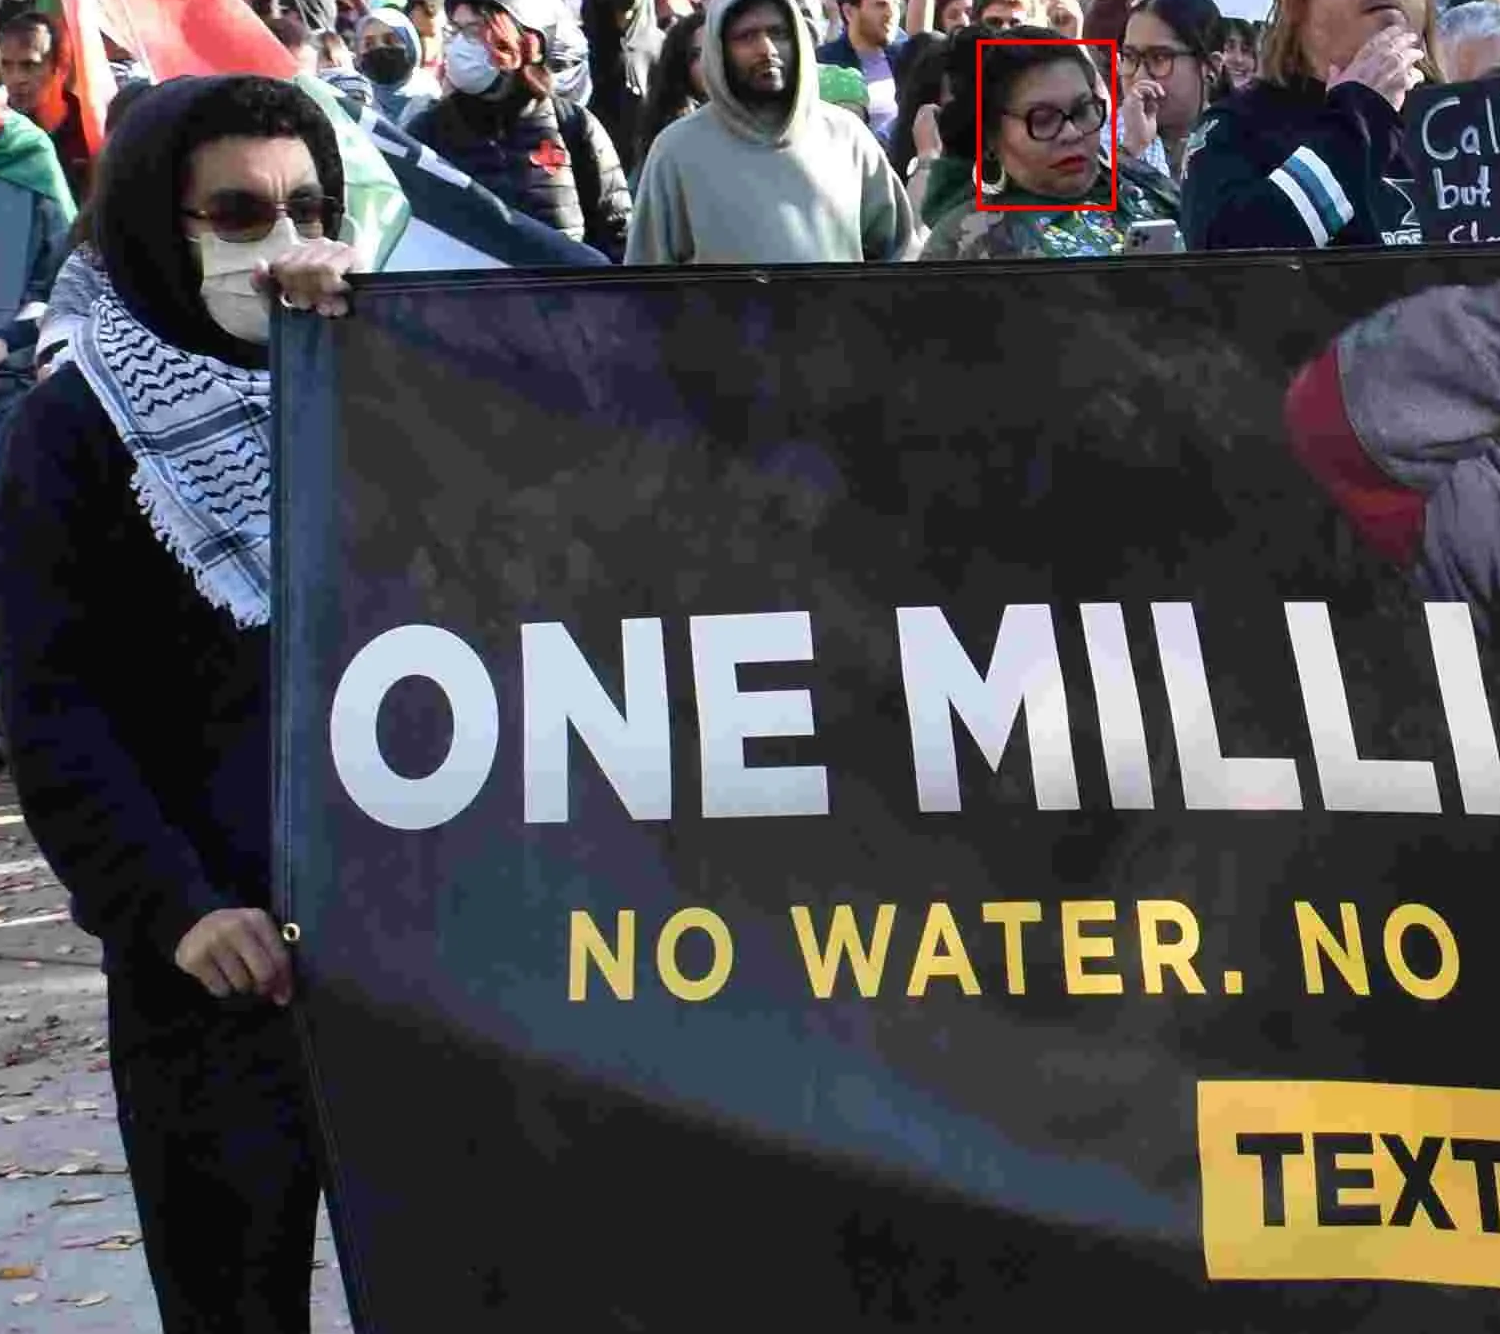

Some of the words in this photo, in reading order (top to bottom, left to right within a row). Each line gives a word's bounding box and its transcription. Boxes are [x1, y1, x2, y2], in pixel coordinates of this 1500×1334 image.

[1435, 165, 1491, 210] but
[329, 610, 832, 831] ONE
[566, 906, 735, 1002] NO
[788, 898, 1246, 998] WATER.
[1293, 899, 1462, 1002] NO
